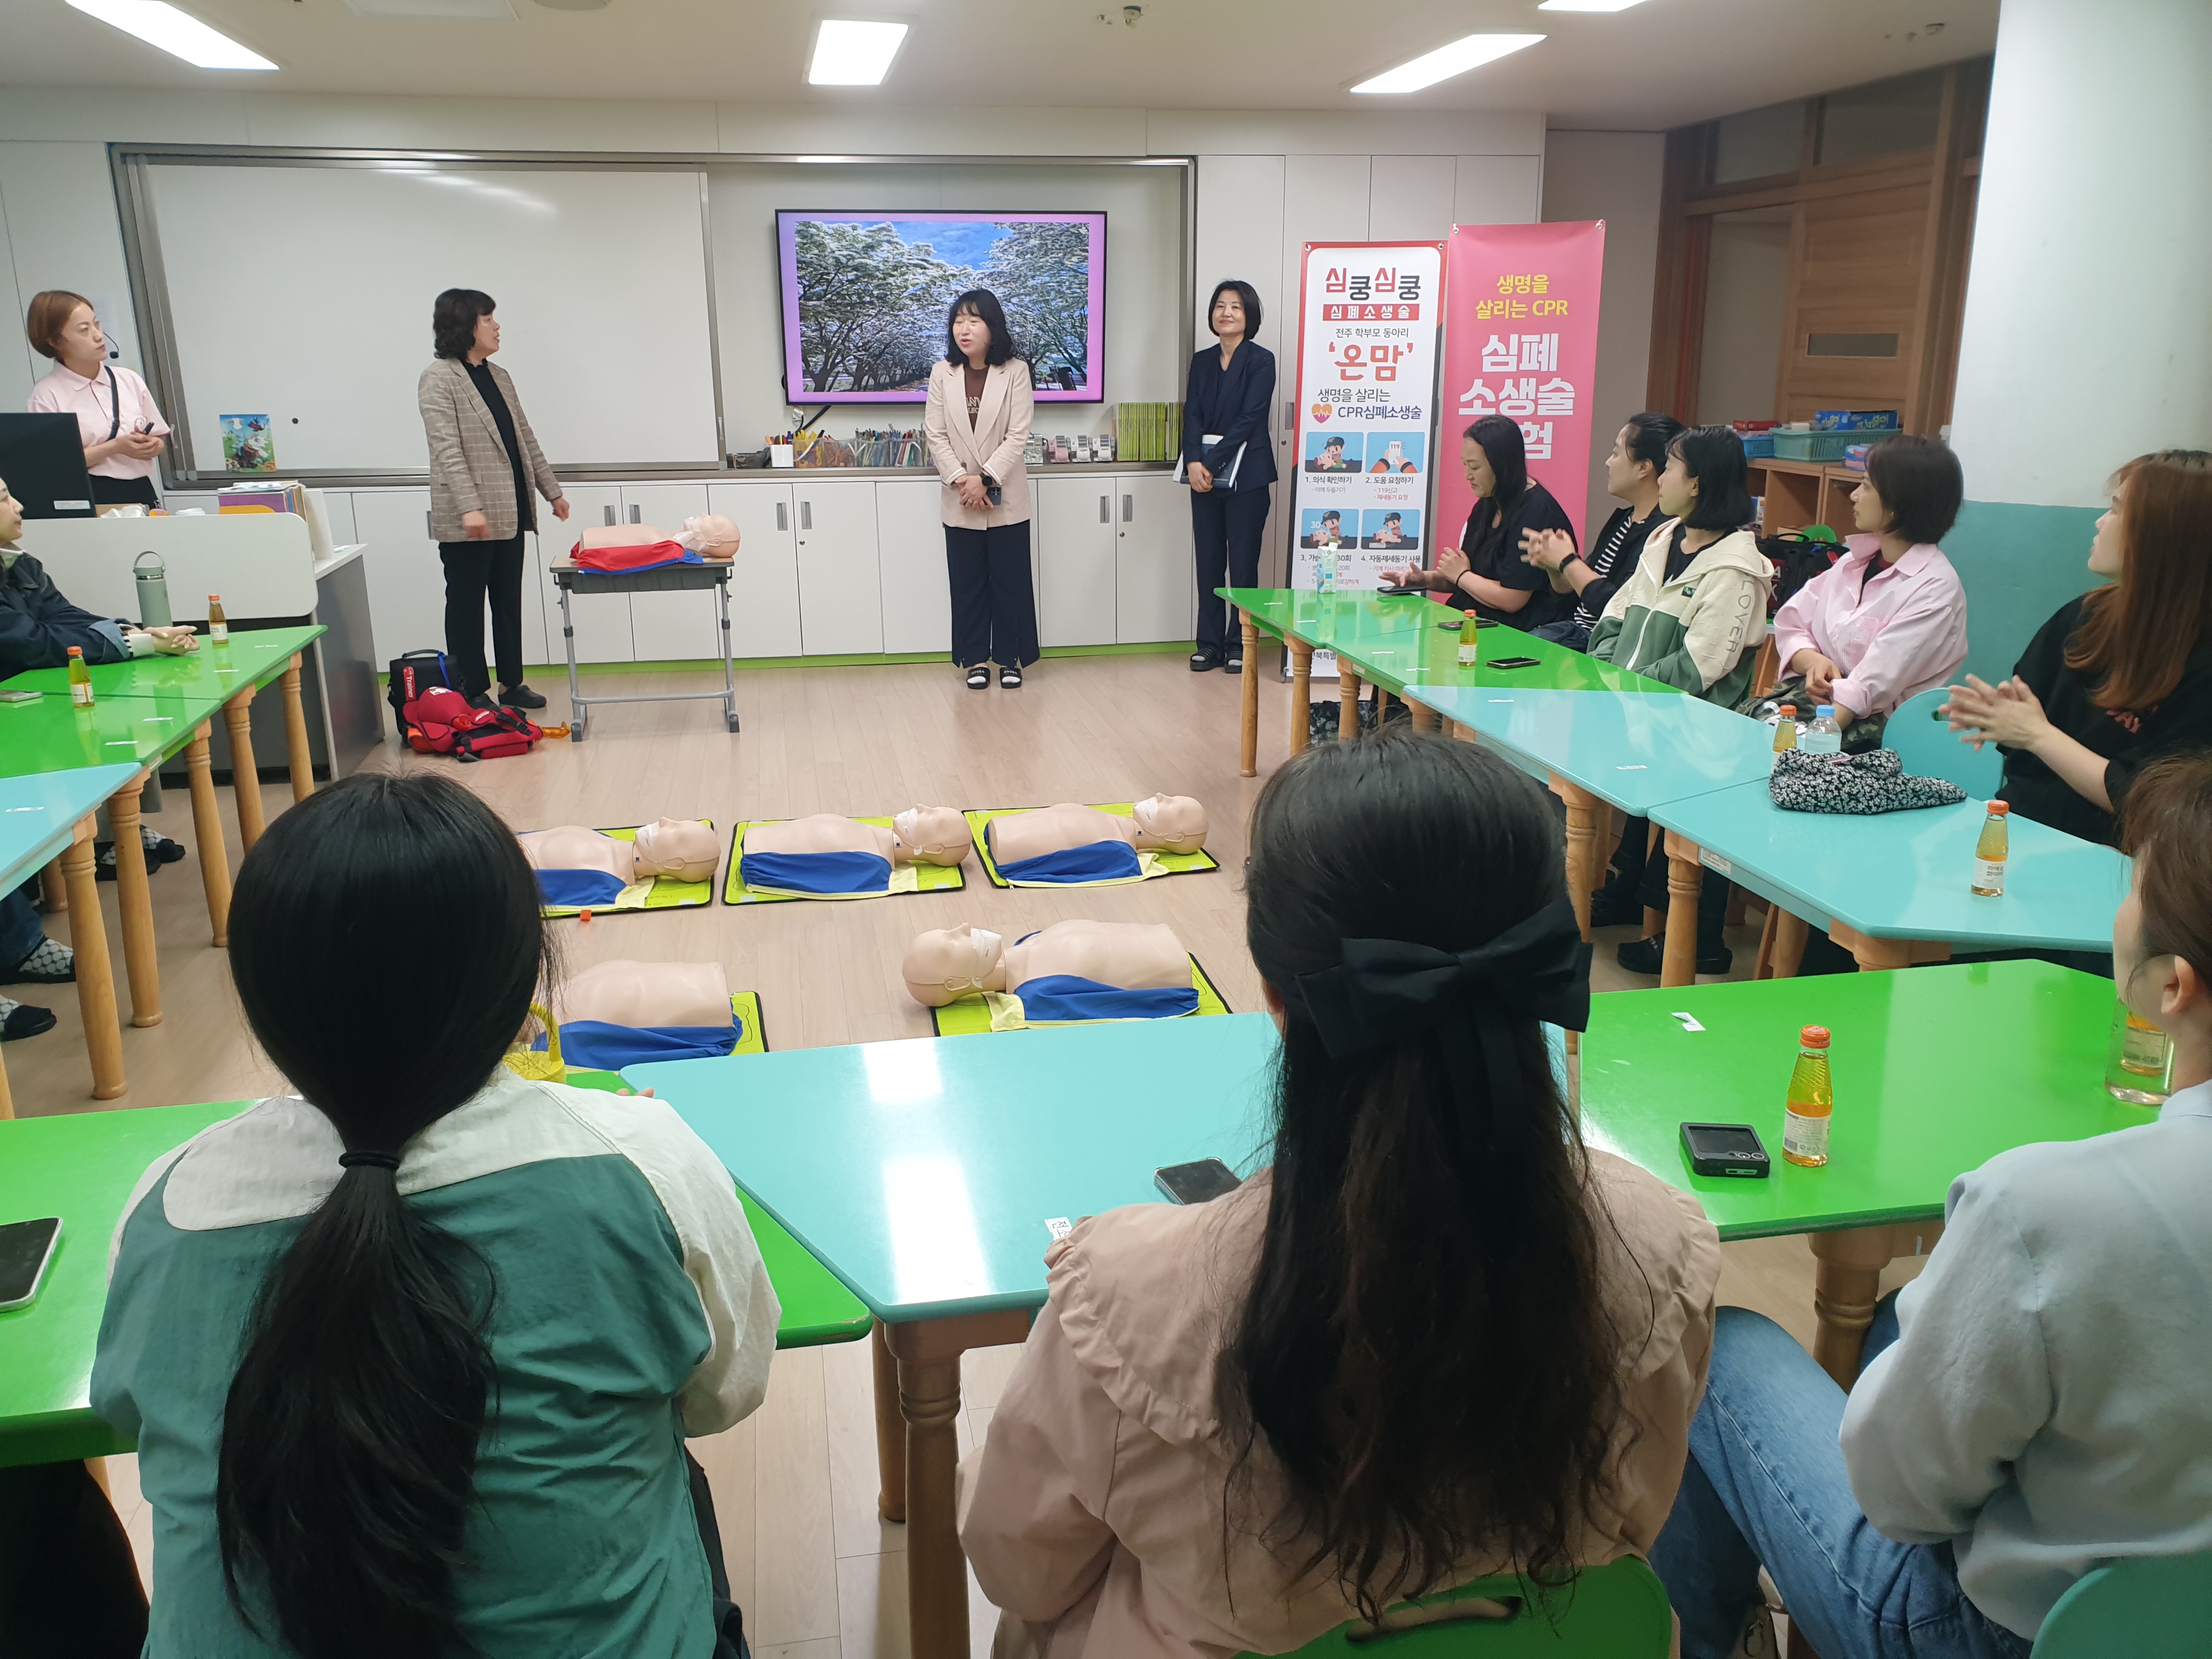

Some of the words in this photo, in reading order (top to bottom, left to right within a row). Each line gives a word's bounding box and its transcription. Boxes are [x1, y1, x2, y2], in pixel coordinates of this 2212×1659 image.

[1325, 268, 1421, 301] 심쿵심쿵
[1496, 274, 1549, 295] 생명을
[1330, 305, 1410, 319] 심폐소생술
[1475, 300, 1528, 319] 살리는
[1532, 300, 1568, 316] CPR
[1335, 328, 1353, 338] 전주
[1355, 328, 1381, 338] 학부모
[1383, 328, 1409, 338] 동아리
[1482, 334, 1559, 372] 심폐
[1318, 388, 1353, 403] 생명을
[1355, 388, 1391, 402] 살리는
[1458, 377, 1575, 416] 소생술
[1338, 405, 1423, 420] CPR심폐소생술
[1519, 421, 1553, 459] 험
[1388, 476, 1414, 484] 요청하기
[1311, 521, 1321, 529] 30
[1408, 555, 1421, 563] 사용
